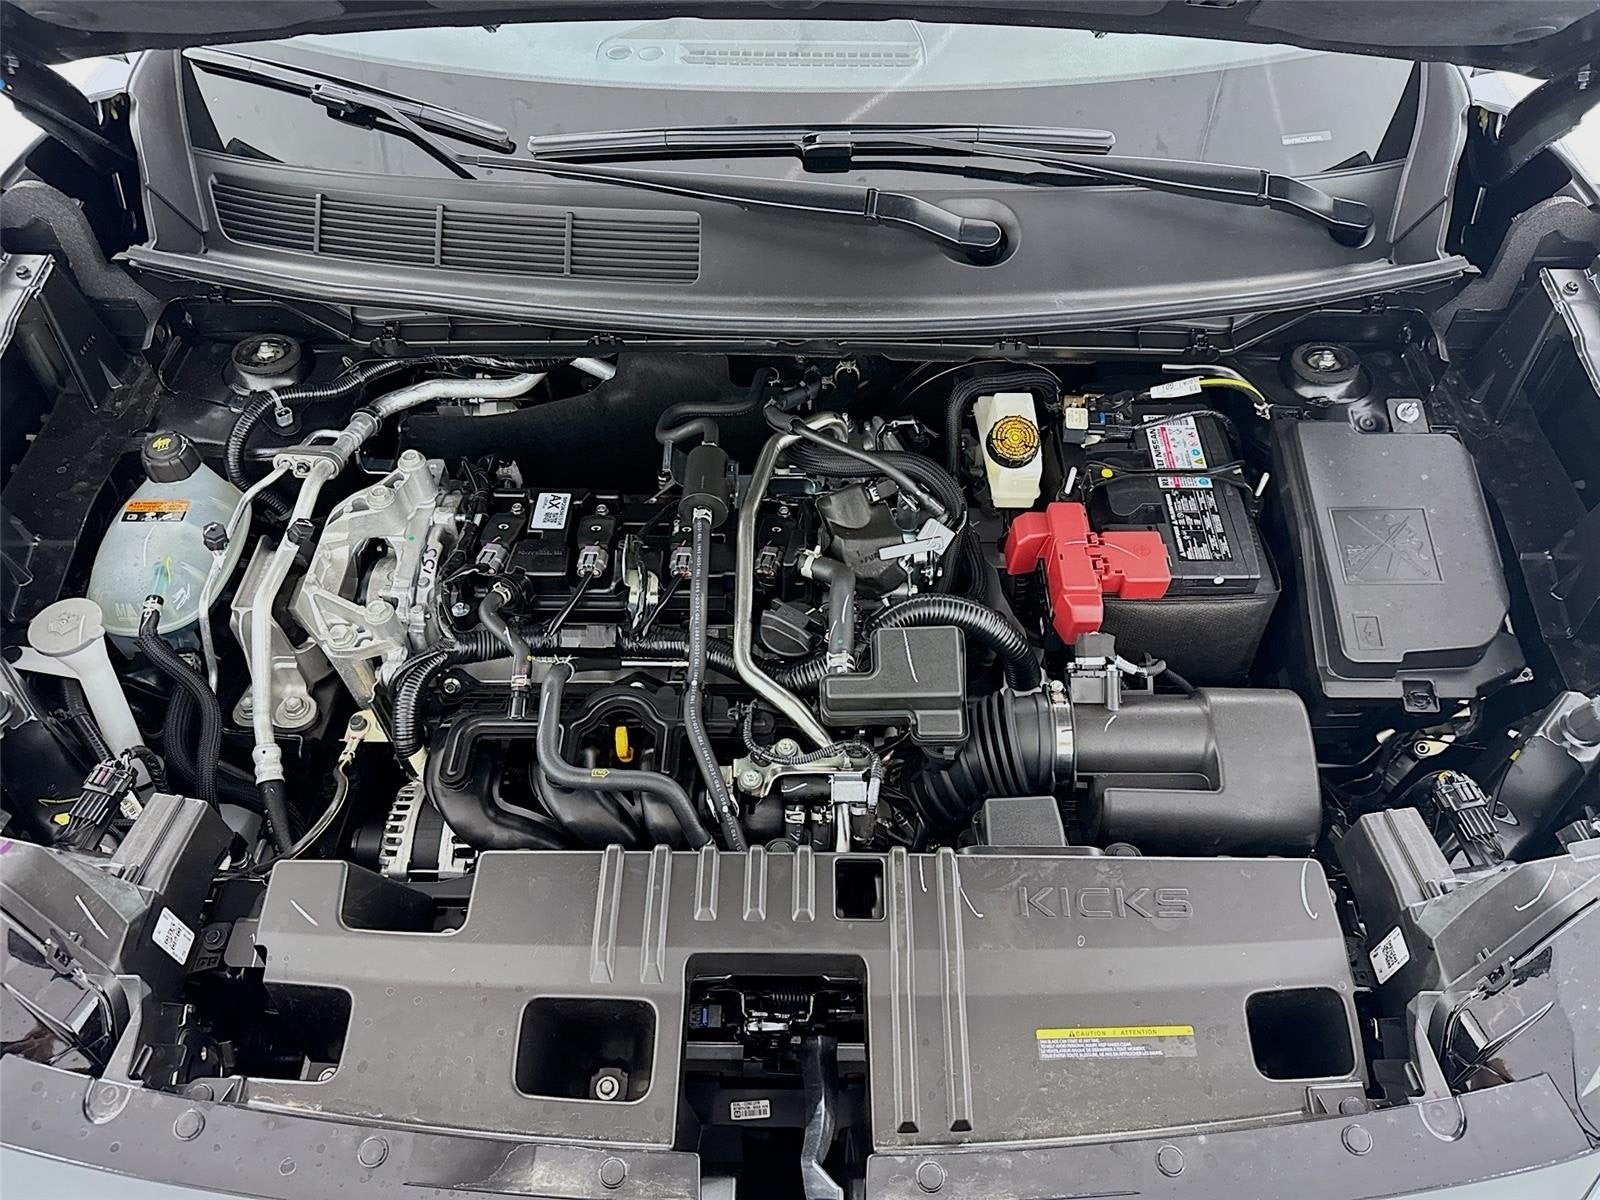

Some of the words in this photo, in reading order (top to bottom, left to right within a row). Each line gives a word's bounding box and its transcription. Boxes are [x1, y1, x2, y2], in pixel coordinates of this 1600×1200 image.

[1150, 429, 1162, 458] NISSAN
[547, 494, 561, 509] AX
[1018, 886, 1194, 918] KICKS
